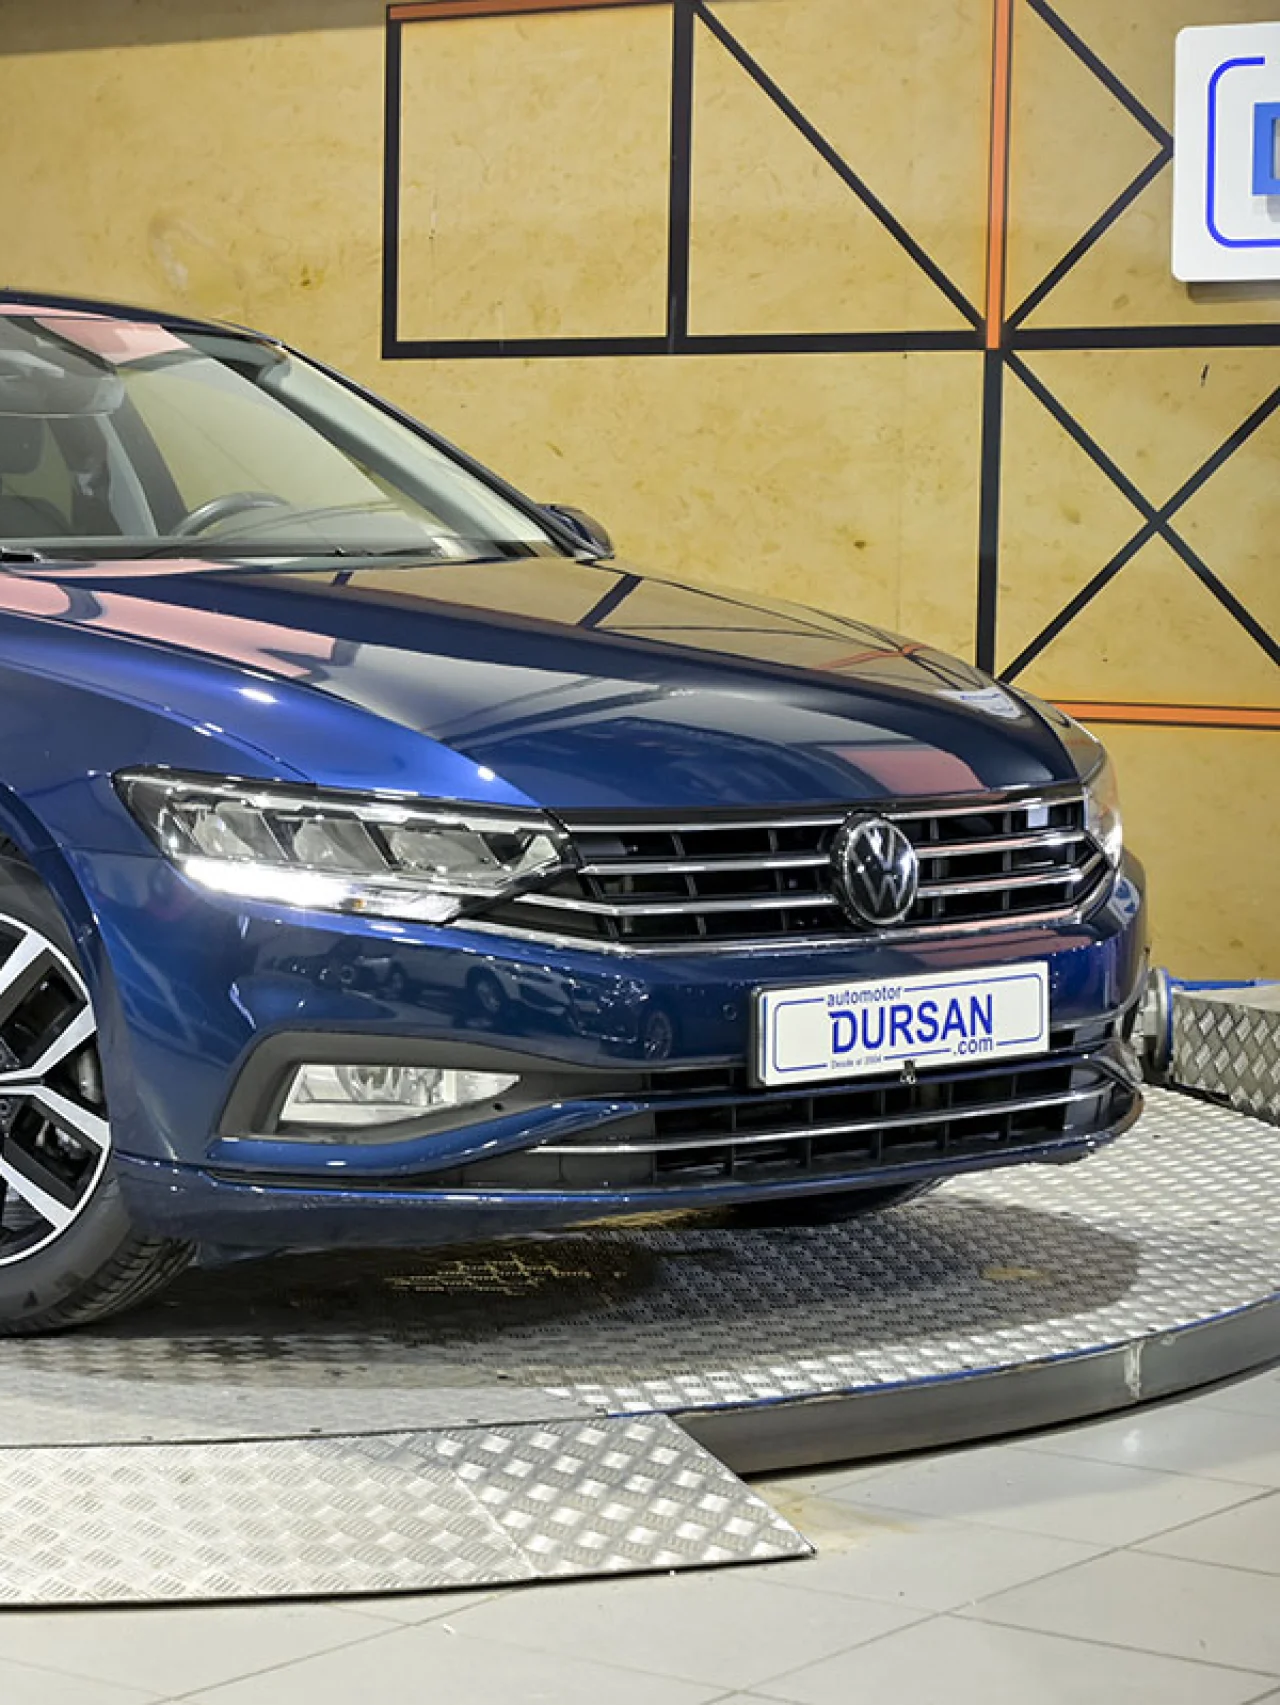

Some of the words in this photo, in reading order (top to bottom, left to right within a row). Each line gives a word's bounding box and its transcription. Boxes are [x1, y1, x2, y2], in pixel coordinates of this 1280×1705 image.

[827, 986, 902, 1007] automotor
[828, 994, 993, 1054] DURSAN
[953, 1037, 993, 1056] .com
